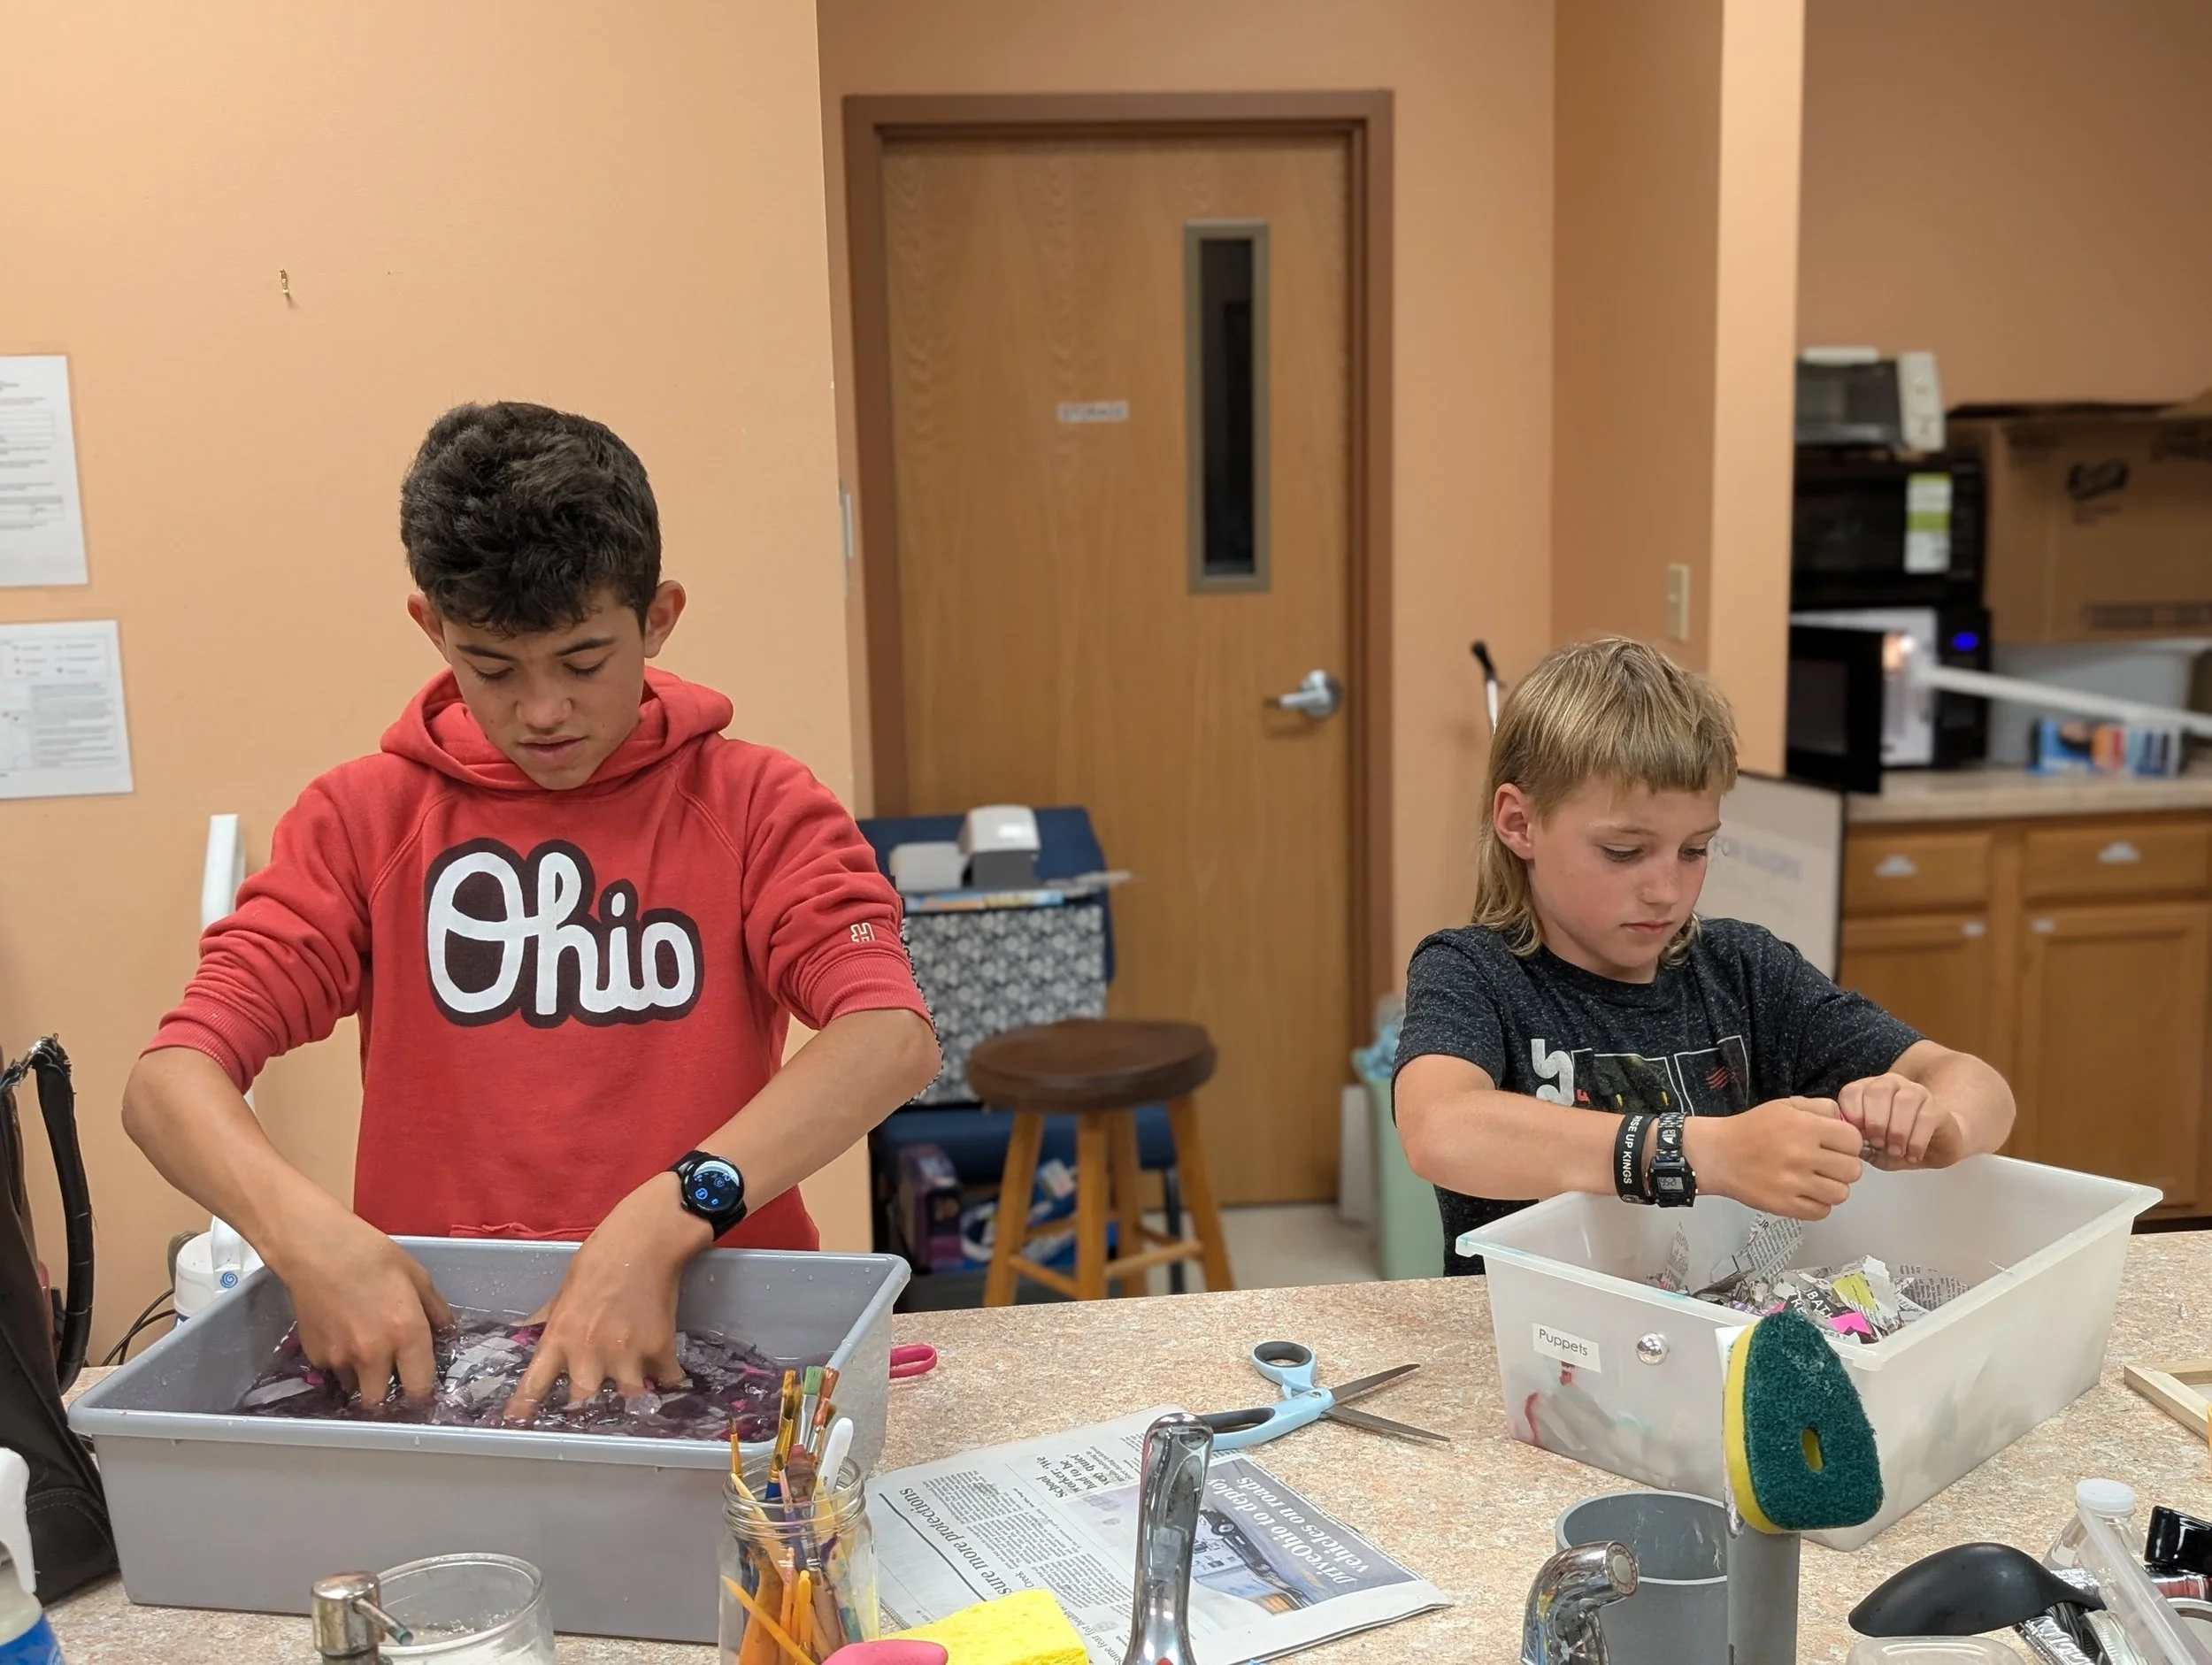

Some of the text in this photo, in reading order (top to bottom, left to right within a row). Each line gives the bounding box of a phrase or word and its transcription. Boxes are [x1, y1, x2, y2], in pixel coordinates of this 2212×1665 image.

[426, 849, 696, 1017] Ohio
[1622, 1115, 1643, 1184] RISE UP KINGS
[1539, 1328, 1588, 1356] Puppets
[1036, 1475, 1068, 1498] School
[1050, 1468, 1081, 1492] worker:
[1060, 1460, 1097, 1490] had to be
[1089, 1472, 1110, 1485] very
[899, 1487, 965, 1542] protections
[1236, 1476, 1371, 1573] vehicles on roads
[1207, 1478, 1359, 1584] DriveOhio to deploy
[953, 1541, 989, 1570] more
[1015, 1570, 1034, 1588] Creek
[1082, 1625, 1095, 1637] for
[1091, 1634, 1108, 1648] fear
